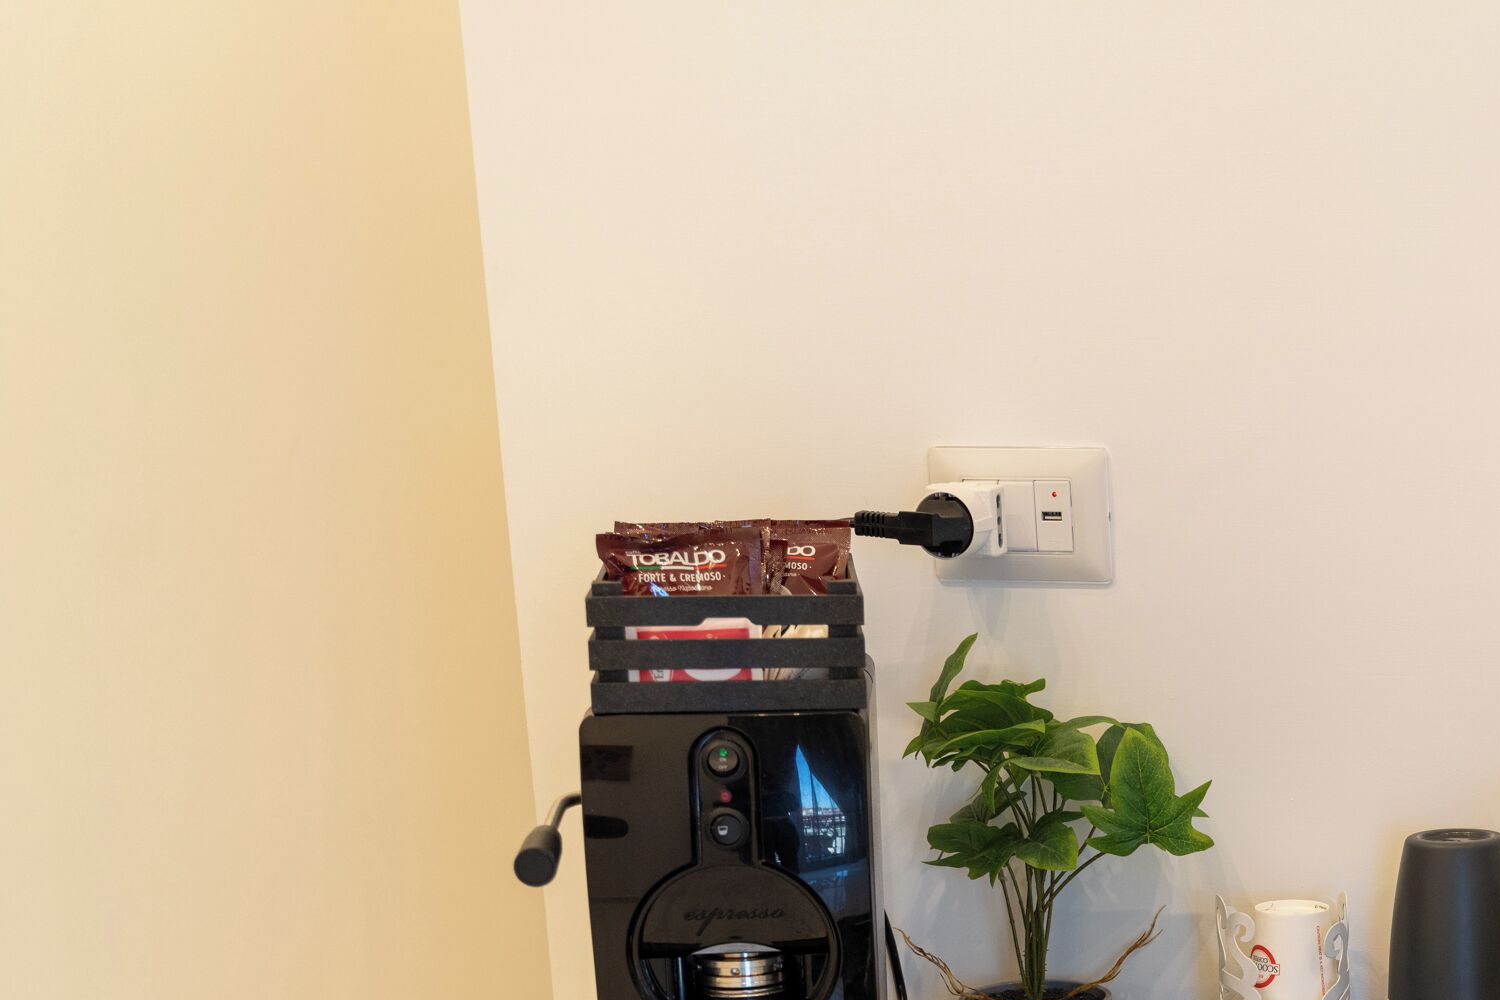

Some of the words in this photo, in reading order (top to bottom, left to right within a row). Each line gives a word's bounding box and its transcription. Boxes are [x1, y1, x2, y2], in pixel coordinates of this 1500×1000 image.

[786, 545, 816, 557] DO
[626, 549, 726, 567] TOBALDO
[784, 561, 808, 571] MOSO
[638, 573, 666, 583] FORTE
[669, 574, 677, 583] &
[679, 571, 722, 583] CREMOSO
[683, 908, 785, 937] espresso
[1255, 962, 1279, 974] SCOO
